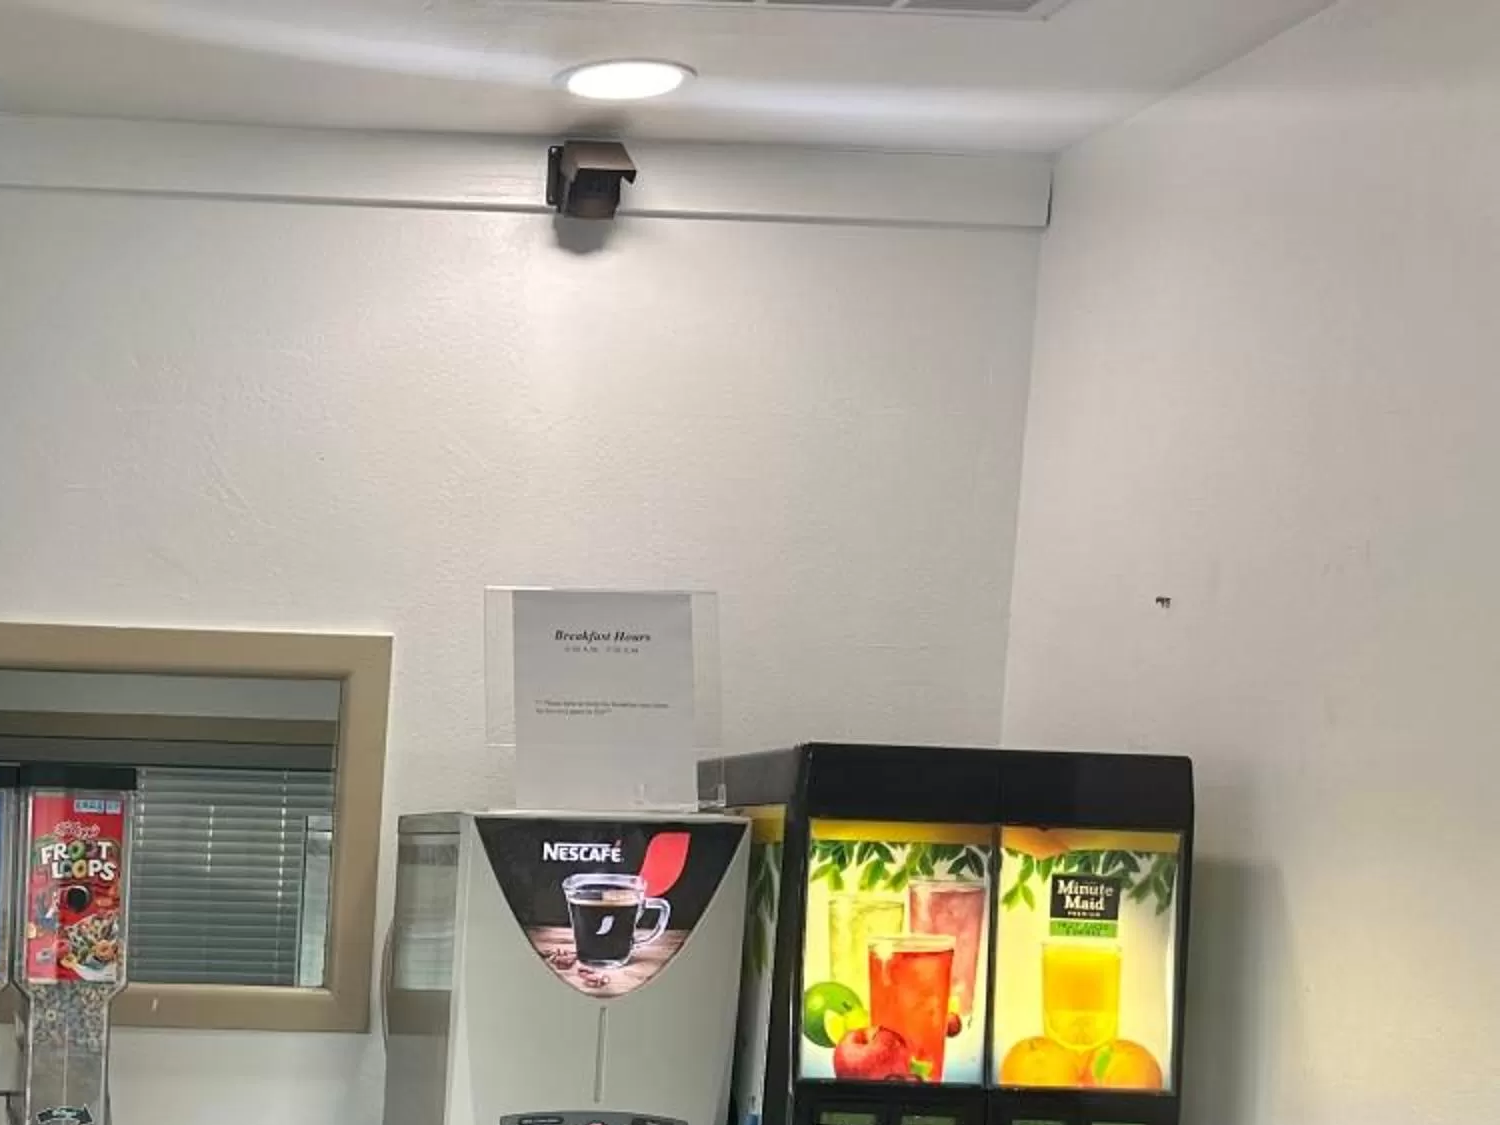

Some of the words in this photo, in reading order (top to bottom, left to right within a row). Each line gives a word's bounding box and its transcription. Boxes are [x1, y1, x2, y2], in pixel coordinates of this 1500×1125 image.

[554, 630, 610, 643] Breakfast
[613, 631, 651, 642] Hours
[543, 840, 623, 863] NESCAFÉ
[51, 860, 117, 882] LOOPS
[1057, 879, 1114, 897] Minute
[1064, 895, 1105, 911] Maid
